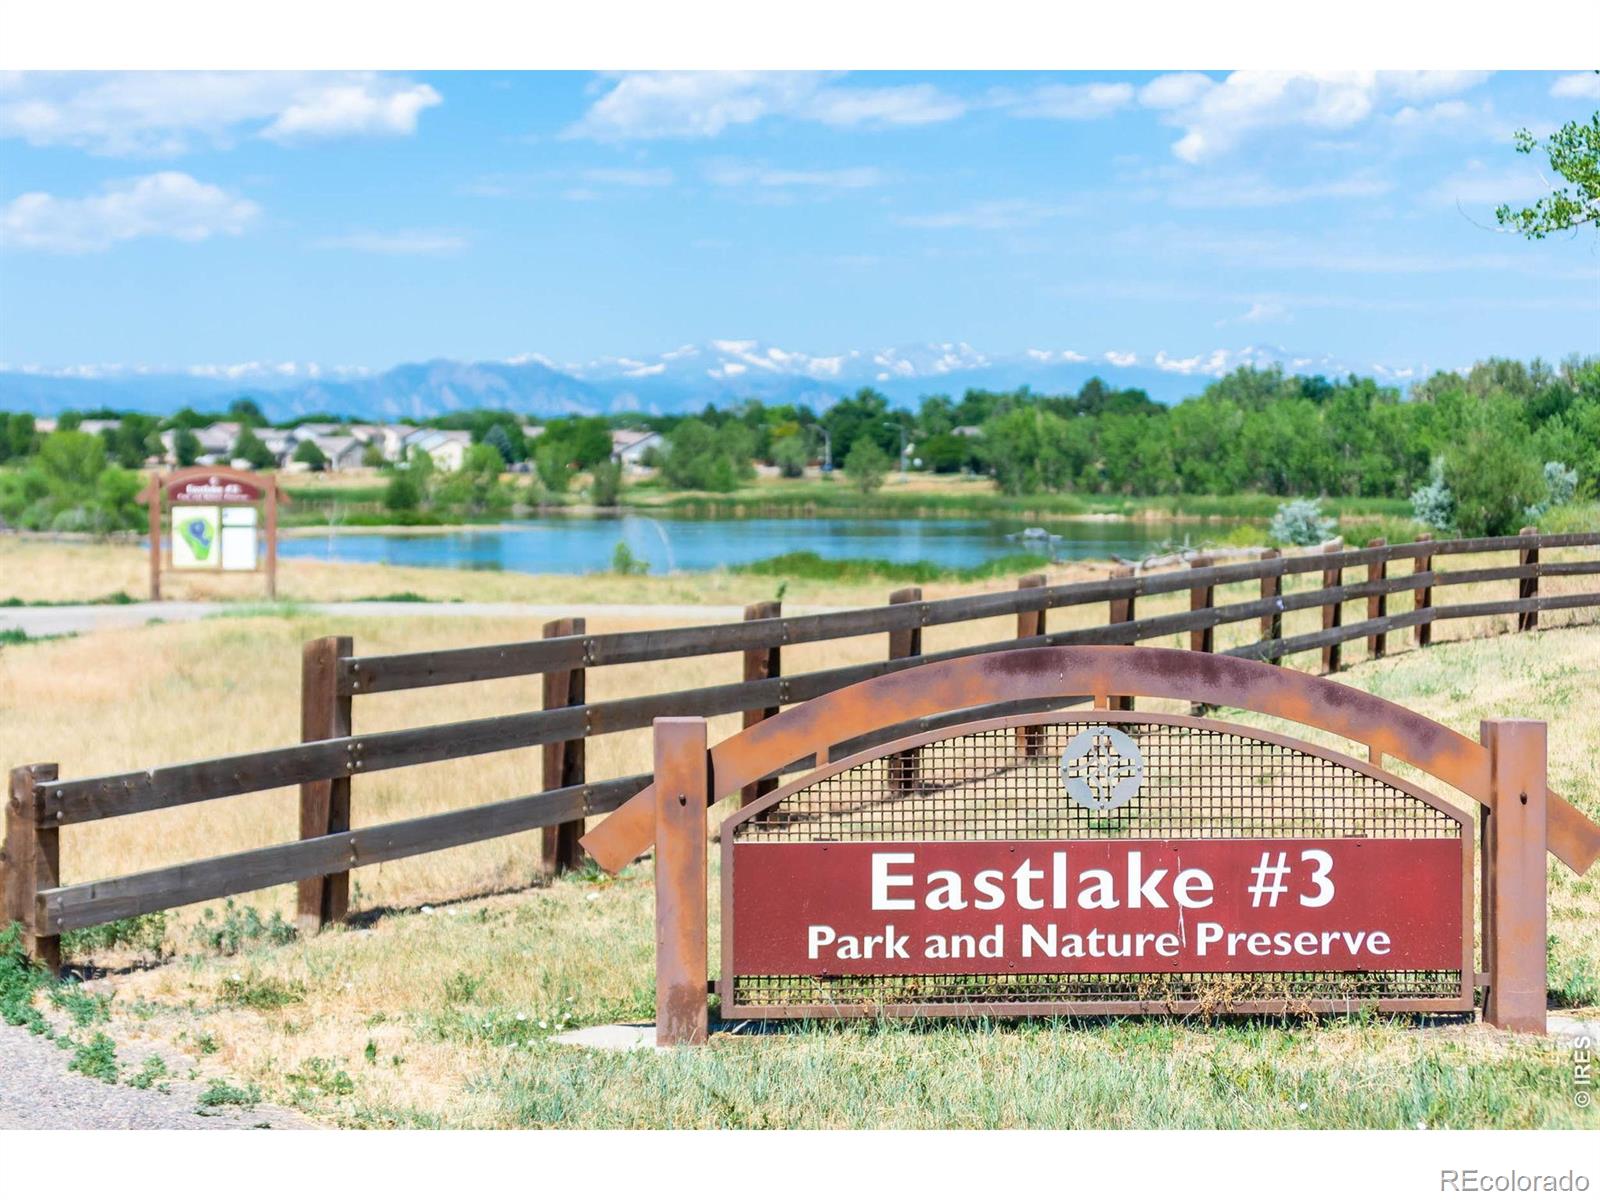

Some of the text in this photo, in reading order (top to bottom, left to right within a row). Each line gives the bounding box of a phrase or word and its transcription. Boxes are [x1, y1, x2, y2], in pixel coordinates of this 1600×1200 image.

[870, 849, 1335, 912] Eastlake #3
[808, 922, 1391, 961] Park and Nature Preserve
